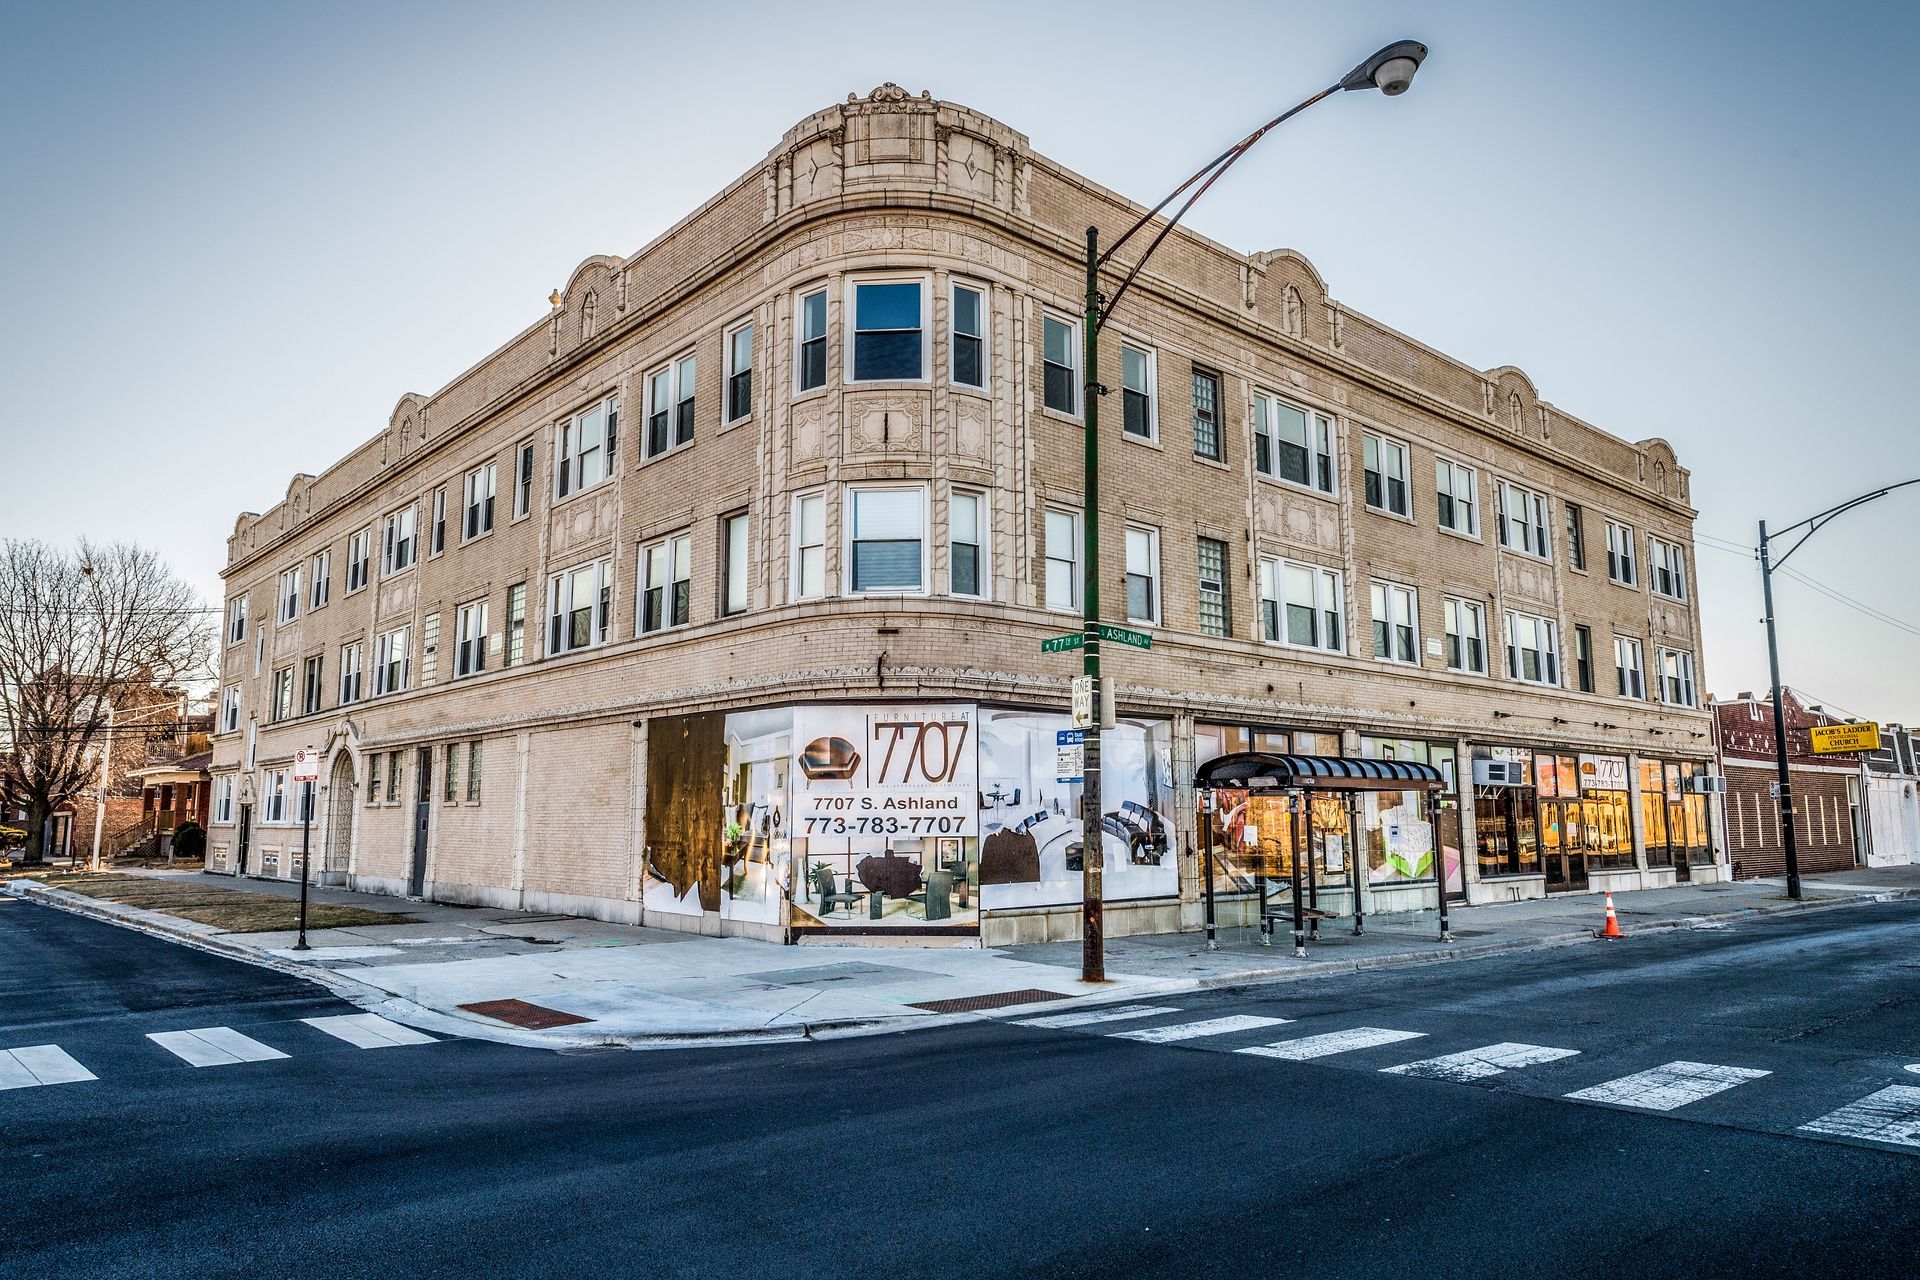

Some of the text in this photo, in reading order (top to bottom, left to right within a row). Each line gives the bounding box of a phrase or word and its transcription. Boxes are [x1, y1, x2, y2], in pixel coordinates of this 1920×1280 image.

[1052, 638, 1071, 651] 77TH
[1073, 637, 1080, 645] ST
[1106, 628, 1143, 646] ASHLAND
[1074, 681, 1090, 694] ONE
[1074, 695, 1090, 708] WAY
[875, 711, 970, 721] FURNITURE AT
[1814, 726, 1871, 737] JACOB'S LADDER
[874, 721, 969, 784] 7707
[1600, 759, 1625, 778] 7707
[813, 796, 958, 810] 7707 S. Ashland
[804, 816, 966, 834] 773-783-7707
